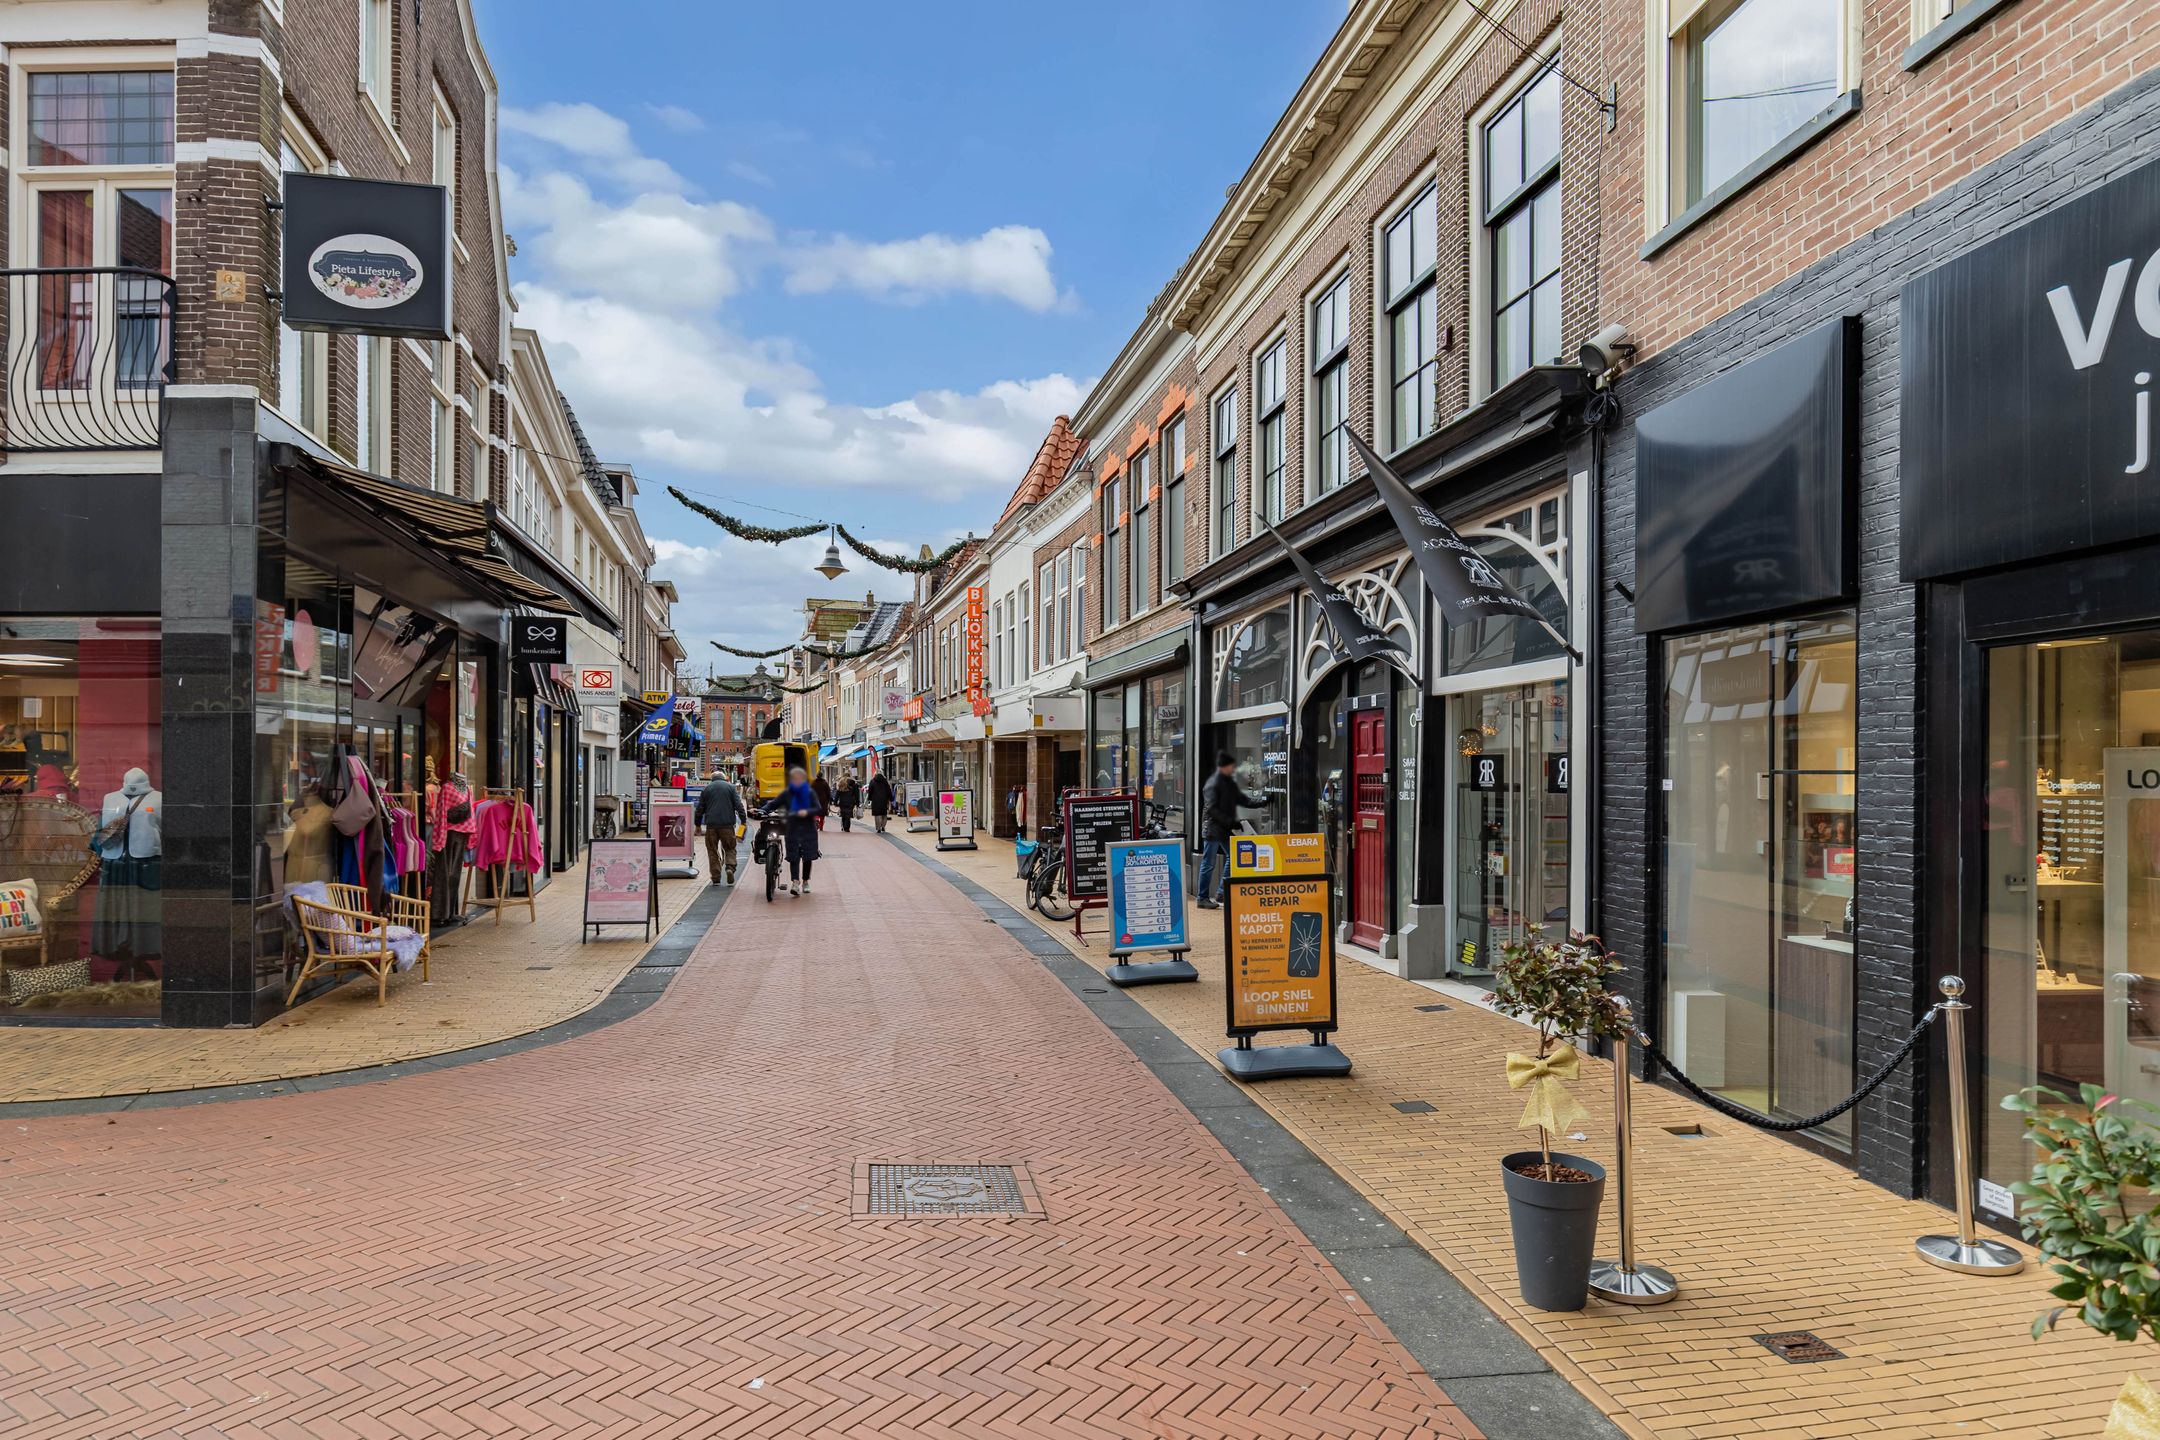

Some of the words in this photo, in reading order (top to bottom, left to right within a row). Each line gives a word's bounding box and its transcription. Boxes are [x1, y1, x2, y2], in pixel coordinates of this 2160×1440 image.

[331, 264, 356, 274] Pieta
[358, 266, 401, 277] Lifestyle
[970, 589, 981, 700] BLOKKER
[642, 732, 666, 742] Primera
[2047, 781, 2101, 791] Openingstijden
[944, 806, 966, 814] SALE
[944, 816, 967, 825] SALE
[1286, 838, 1318, 846] LEBARA
[1240, 884, 1317, 896] ROSENBOOM
[1260, 896, 1299, 907] REPAIR
[0, 900, 25, 915] ERY
[0, 913, 34, 928] ITCH.
[1240, 912, 1283, 923] MOBIEL
[1240, 924, 1284, 935] KAPOT?
[1244, 992, 1279, 1003] LOOP
[1283, 990, 1314, 1001] SNEL
[1257, 1002, 1308, 1014] BINNEN!
